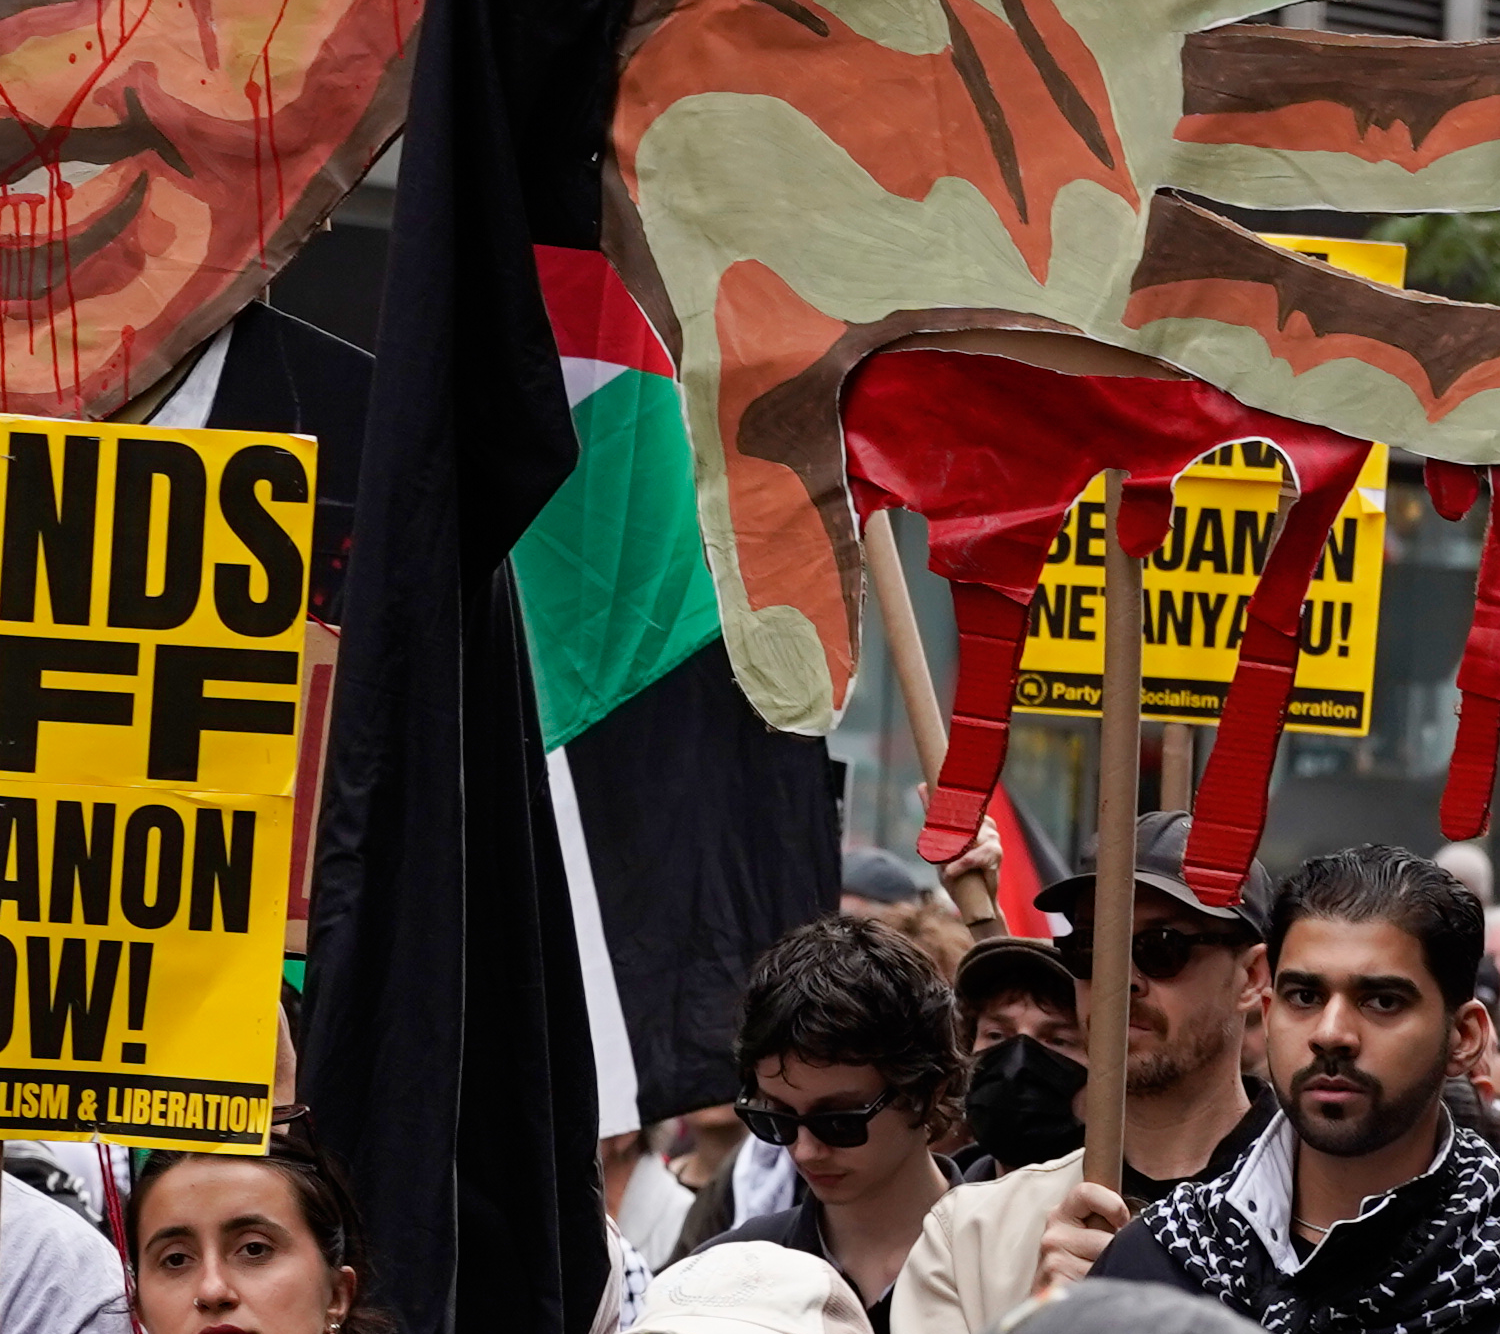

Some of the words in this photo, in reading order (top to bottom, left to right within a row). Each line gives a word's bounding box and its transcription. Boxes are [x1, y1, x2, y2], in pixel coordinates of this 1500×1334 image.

[1052, 682, 1102, 705] Party
[77, 1088, 98, 1122] &
[107, 1087, 267, 1135] LIBERATION
